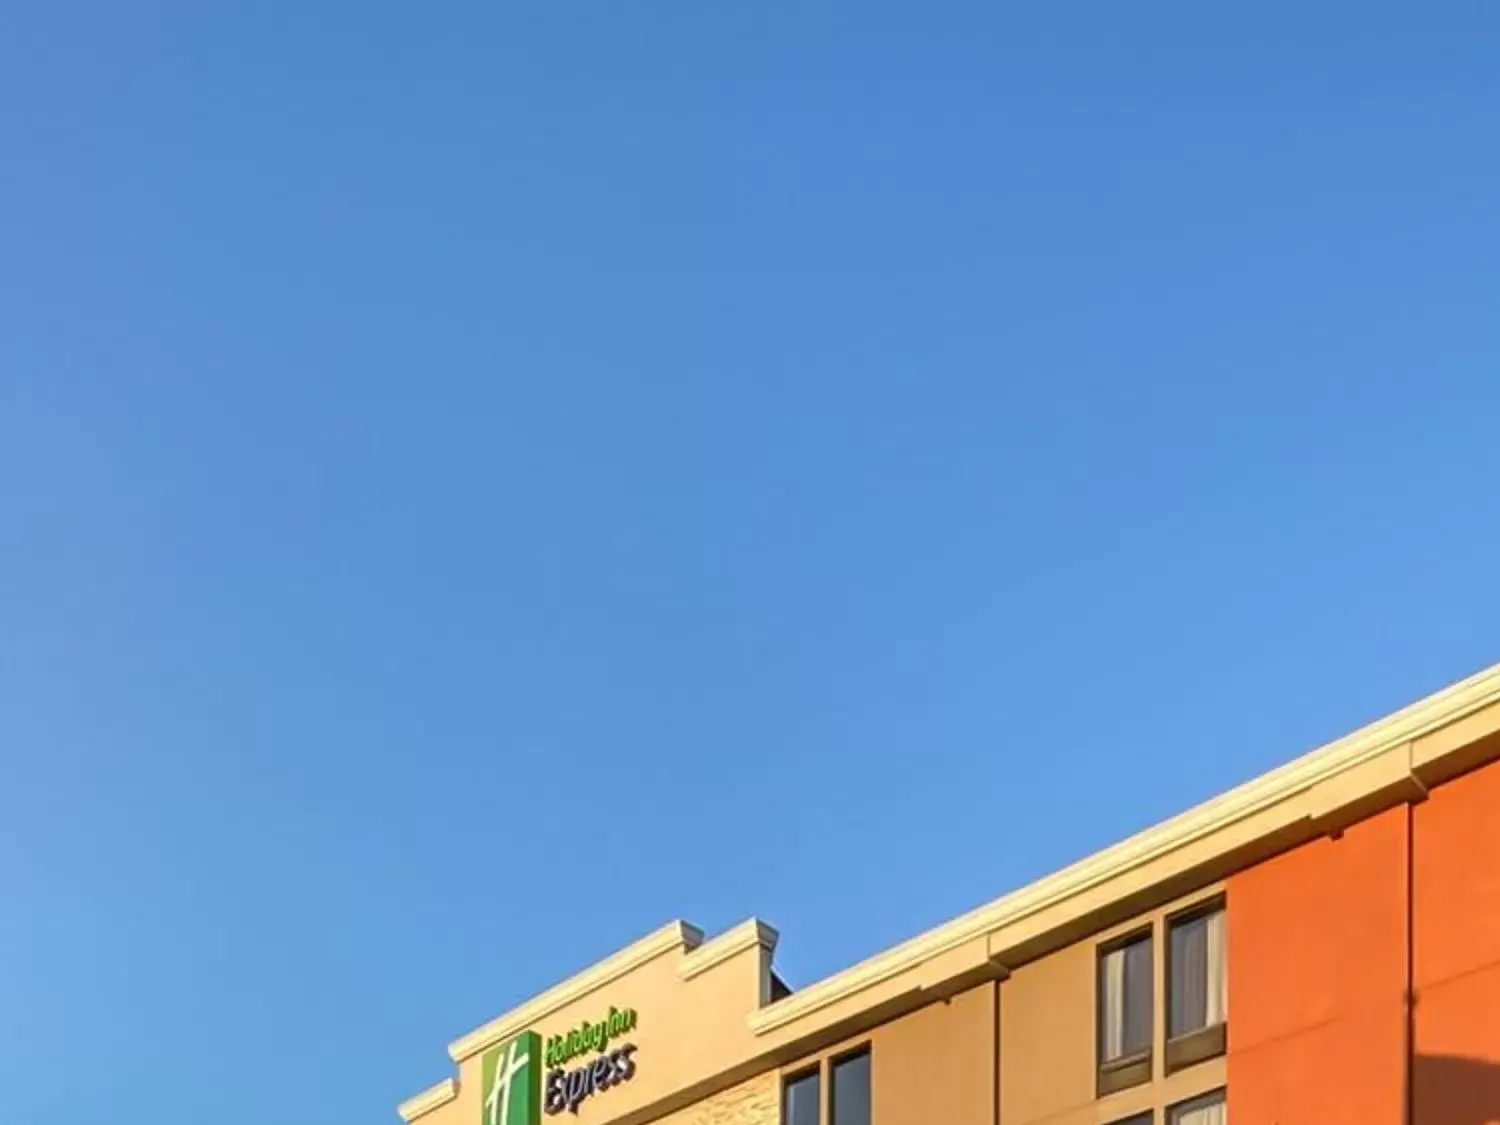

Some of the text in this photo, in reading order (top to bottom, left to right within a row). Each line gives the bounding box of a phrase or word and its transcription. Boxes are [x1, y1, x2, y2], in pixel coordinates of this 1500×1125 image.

[545, 1006, 637, 1068] Holiday Inn
[544, 1043, 637, 1115] Express
